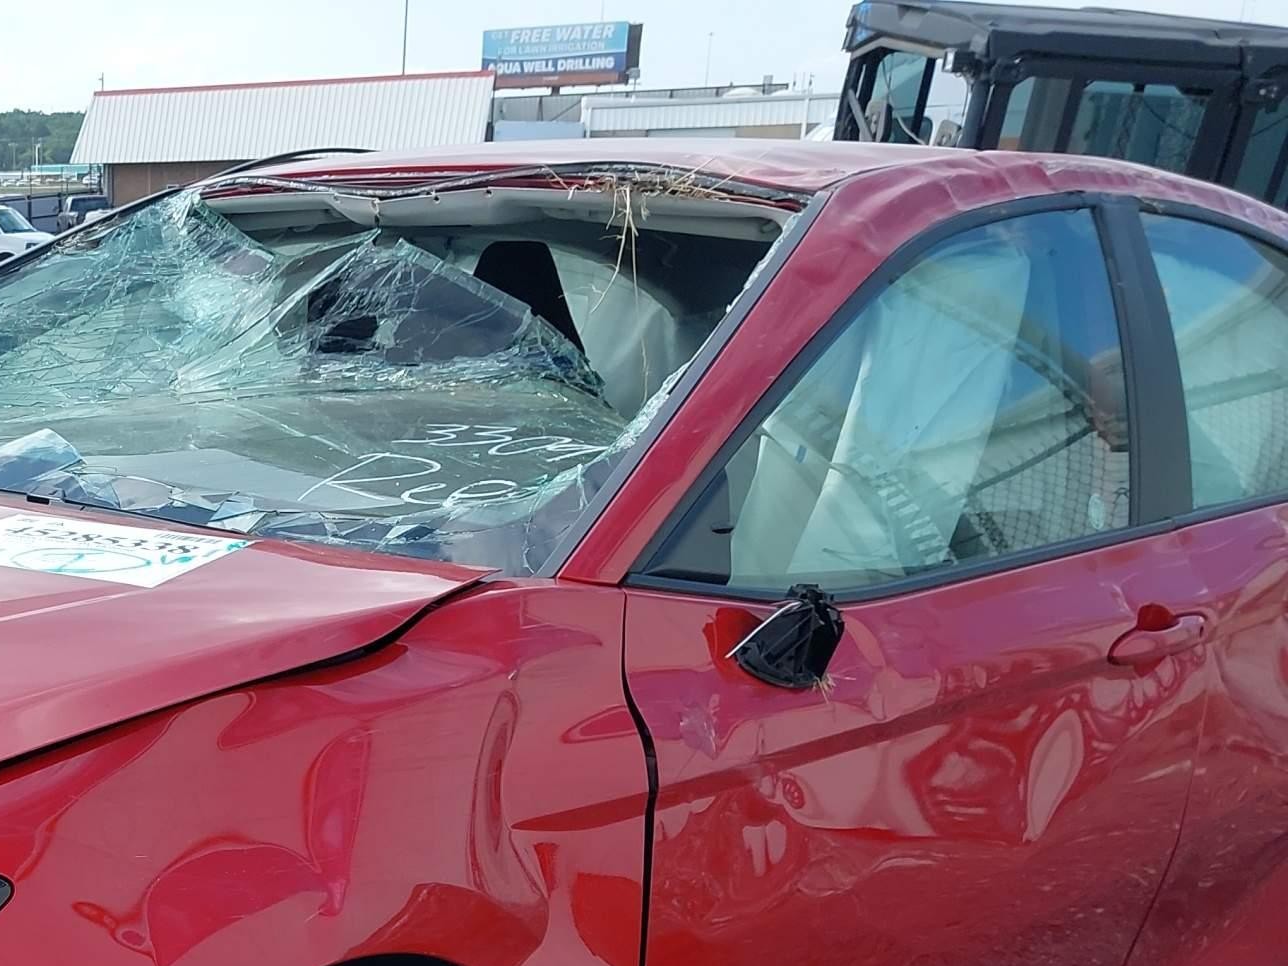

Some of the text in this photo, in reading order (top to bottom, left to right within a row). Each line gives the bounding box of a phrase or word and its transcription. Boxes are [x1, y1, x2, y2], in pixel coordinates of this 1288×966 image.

[510, 26, 554, 44] FREE
[555, 24, 615, 42] WATER
[497, 46, 516, 56] FOR
[523, 60, 555, 73] WELL
[557, 56, 615, 72] DRILLING
[5, 526, 200, 555] 45285338
